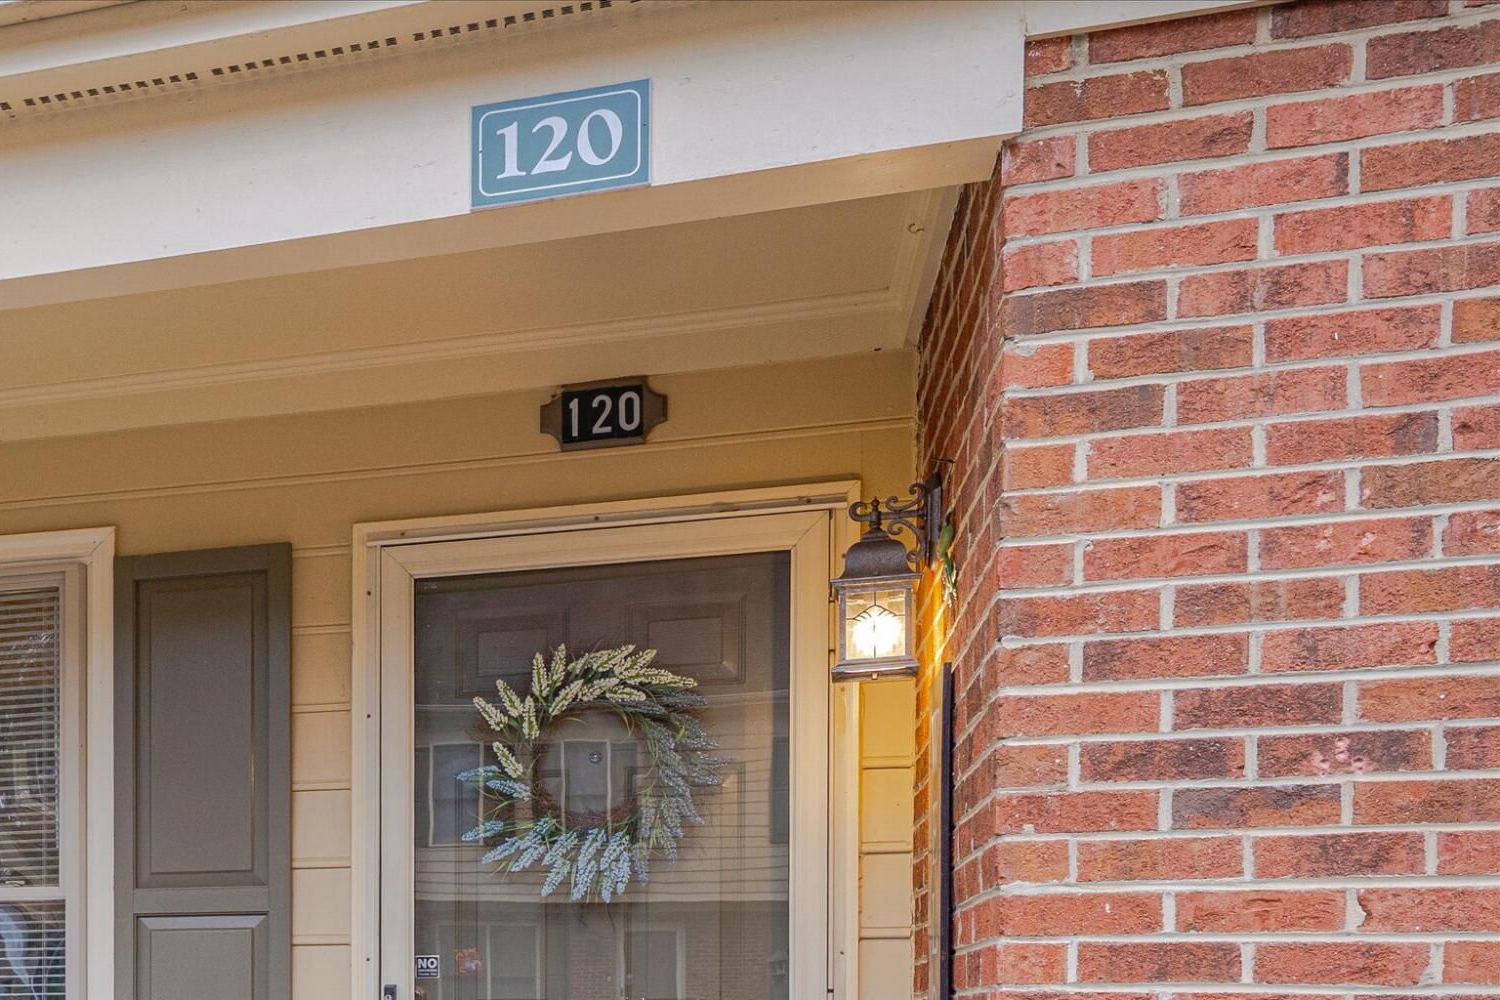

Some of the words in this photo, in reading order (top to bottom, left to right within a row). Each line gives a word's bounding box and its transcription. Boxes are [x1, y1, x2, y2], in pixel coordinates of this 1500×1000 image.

[496, 108, 623, 180] 120
[569, 391, 640, 437] 120
[417, 958, 437, 969] NO
